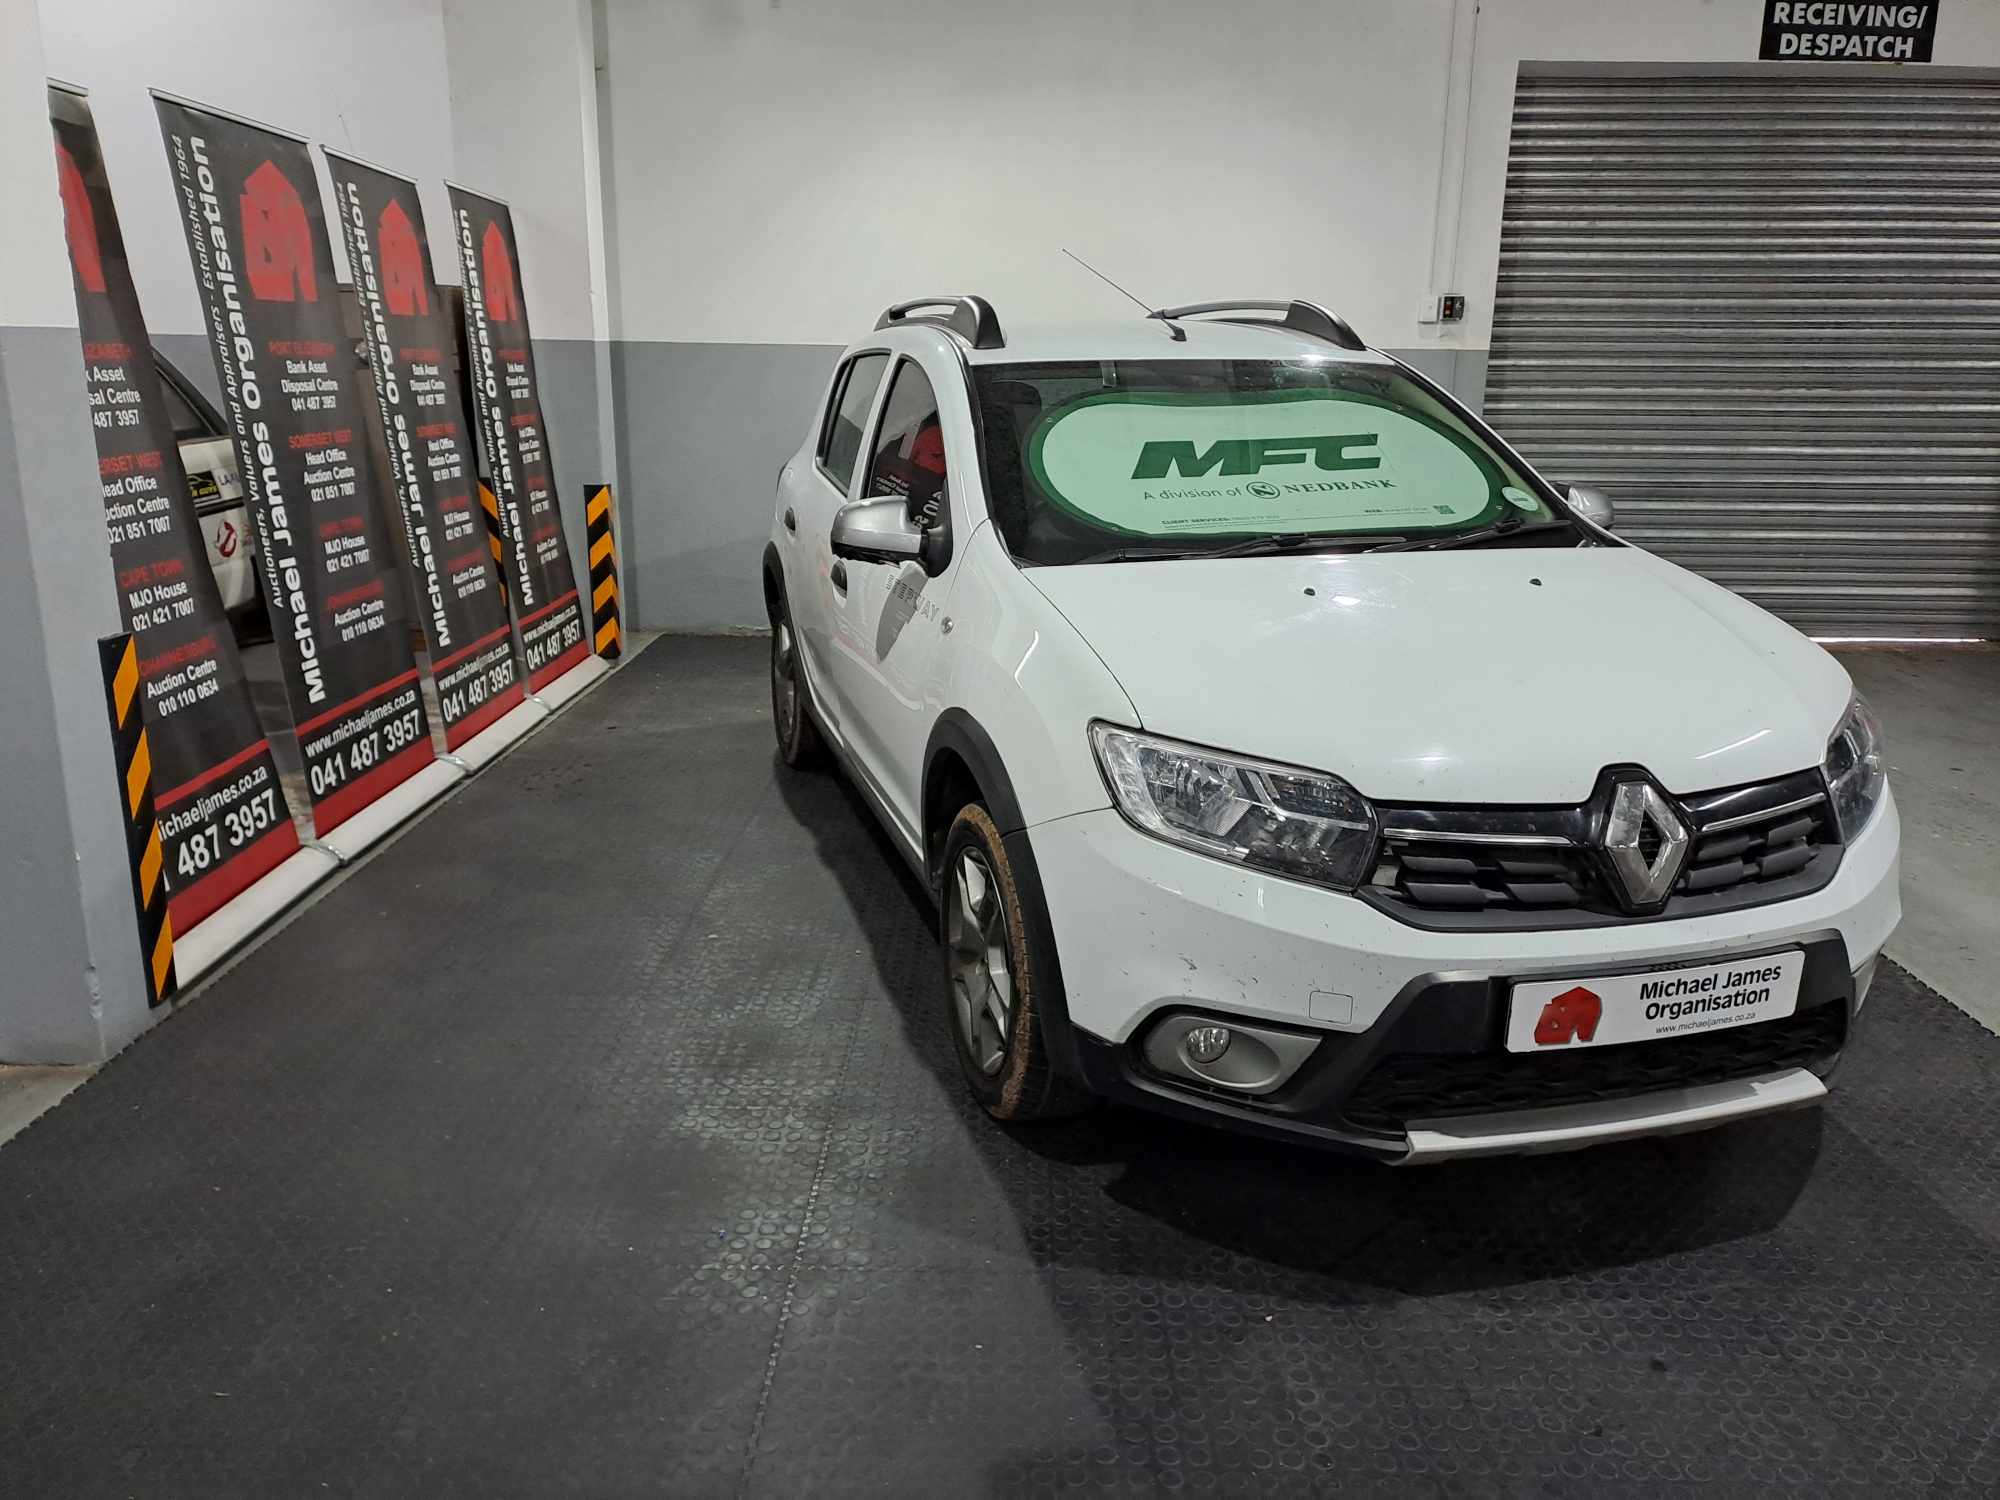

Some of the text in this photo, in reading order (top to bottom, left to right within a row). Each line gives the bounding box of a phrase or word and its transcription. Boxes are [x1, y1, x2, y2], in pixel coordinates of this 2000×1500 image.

[1773, 1, 1929, 29] RECEIVING/
[1778, 33, 1915, 58] DESPATCH
[170, 134, 192, 184] 1964
[181, 185, 215, 290] Established
[210, 306, 239, 398] Appraisers
[93, 366, 126, 382] Asset
[106, 387, 141, 404] Centre
[378, 396, 391, 425] and
[459, 209, 534, 606] Michael James Organisation
[93, 409, 140, 428] 487 3957
[190, 135, 326, 704] Michael James Organisation
[229, 401, 247, 436] and
[346, 182, 451, 648] Michael James Organisation
[239, 440, 261, 502] Valuers
[385, 429, 401, 480] Valuers
[1130, 433, 1381, 479] MFC
[124, 474, 158, 494] Office
[1143, 479, 1396, 500] A division of NEDBANK
[136, 496, 171, 514] Centre
[107, 515, 172, 544] 021 851 7007
[254, 508, 285, 608] Auctioneers,
[128, 581, 188, 611] MJO House
[132, 597, 195, 632] 021 421 7007
[526, 618, 580, 670] 041 487 3957
[147, 671, 188, 699] Auction
[158, 677, 220, 717] 010 110 0634
[442, 658, 513, 722] 041 487 3957
[304, 689, 417, 759] www.michaeljames.co.za
[310, 708, 420, 796] 041 487 3957
[177, 787, 277, 876] 487 3957
[1639, 964, 1782, 1001] Michael James
[1645, 987, 1770, 1021] Organisation
[1655, 1011, 1756, 1035] www.michaeljames.co.za
